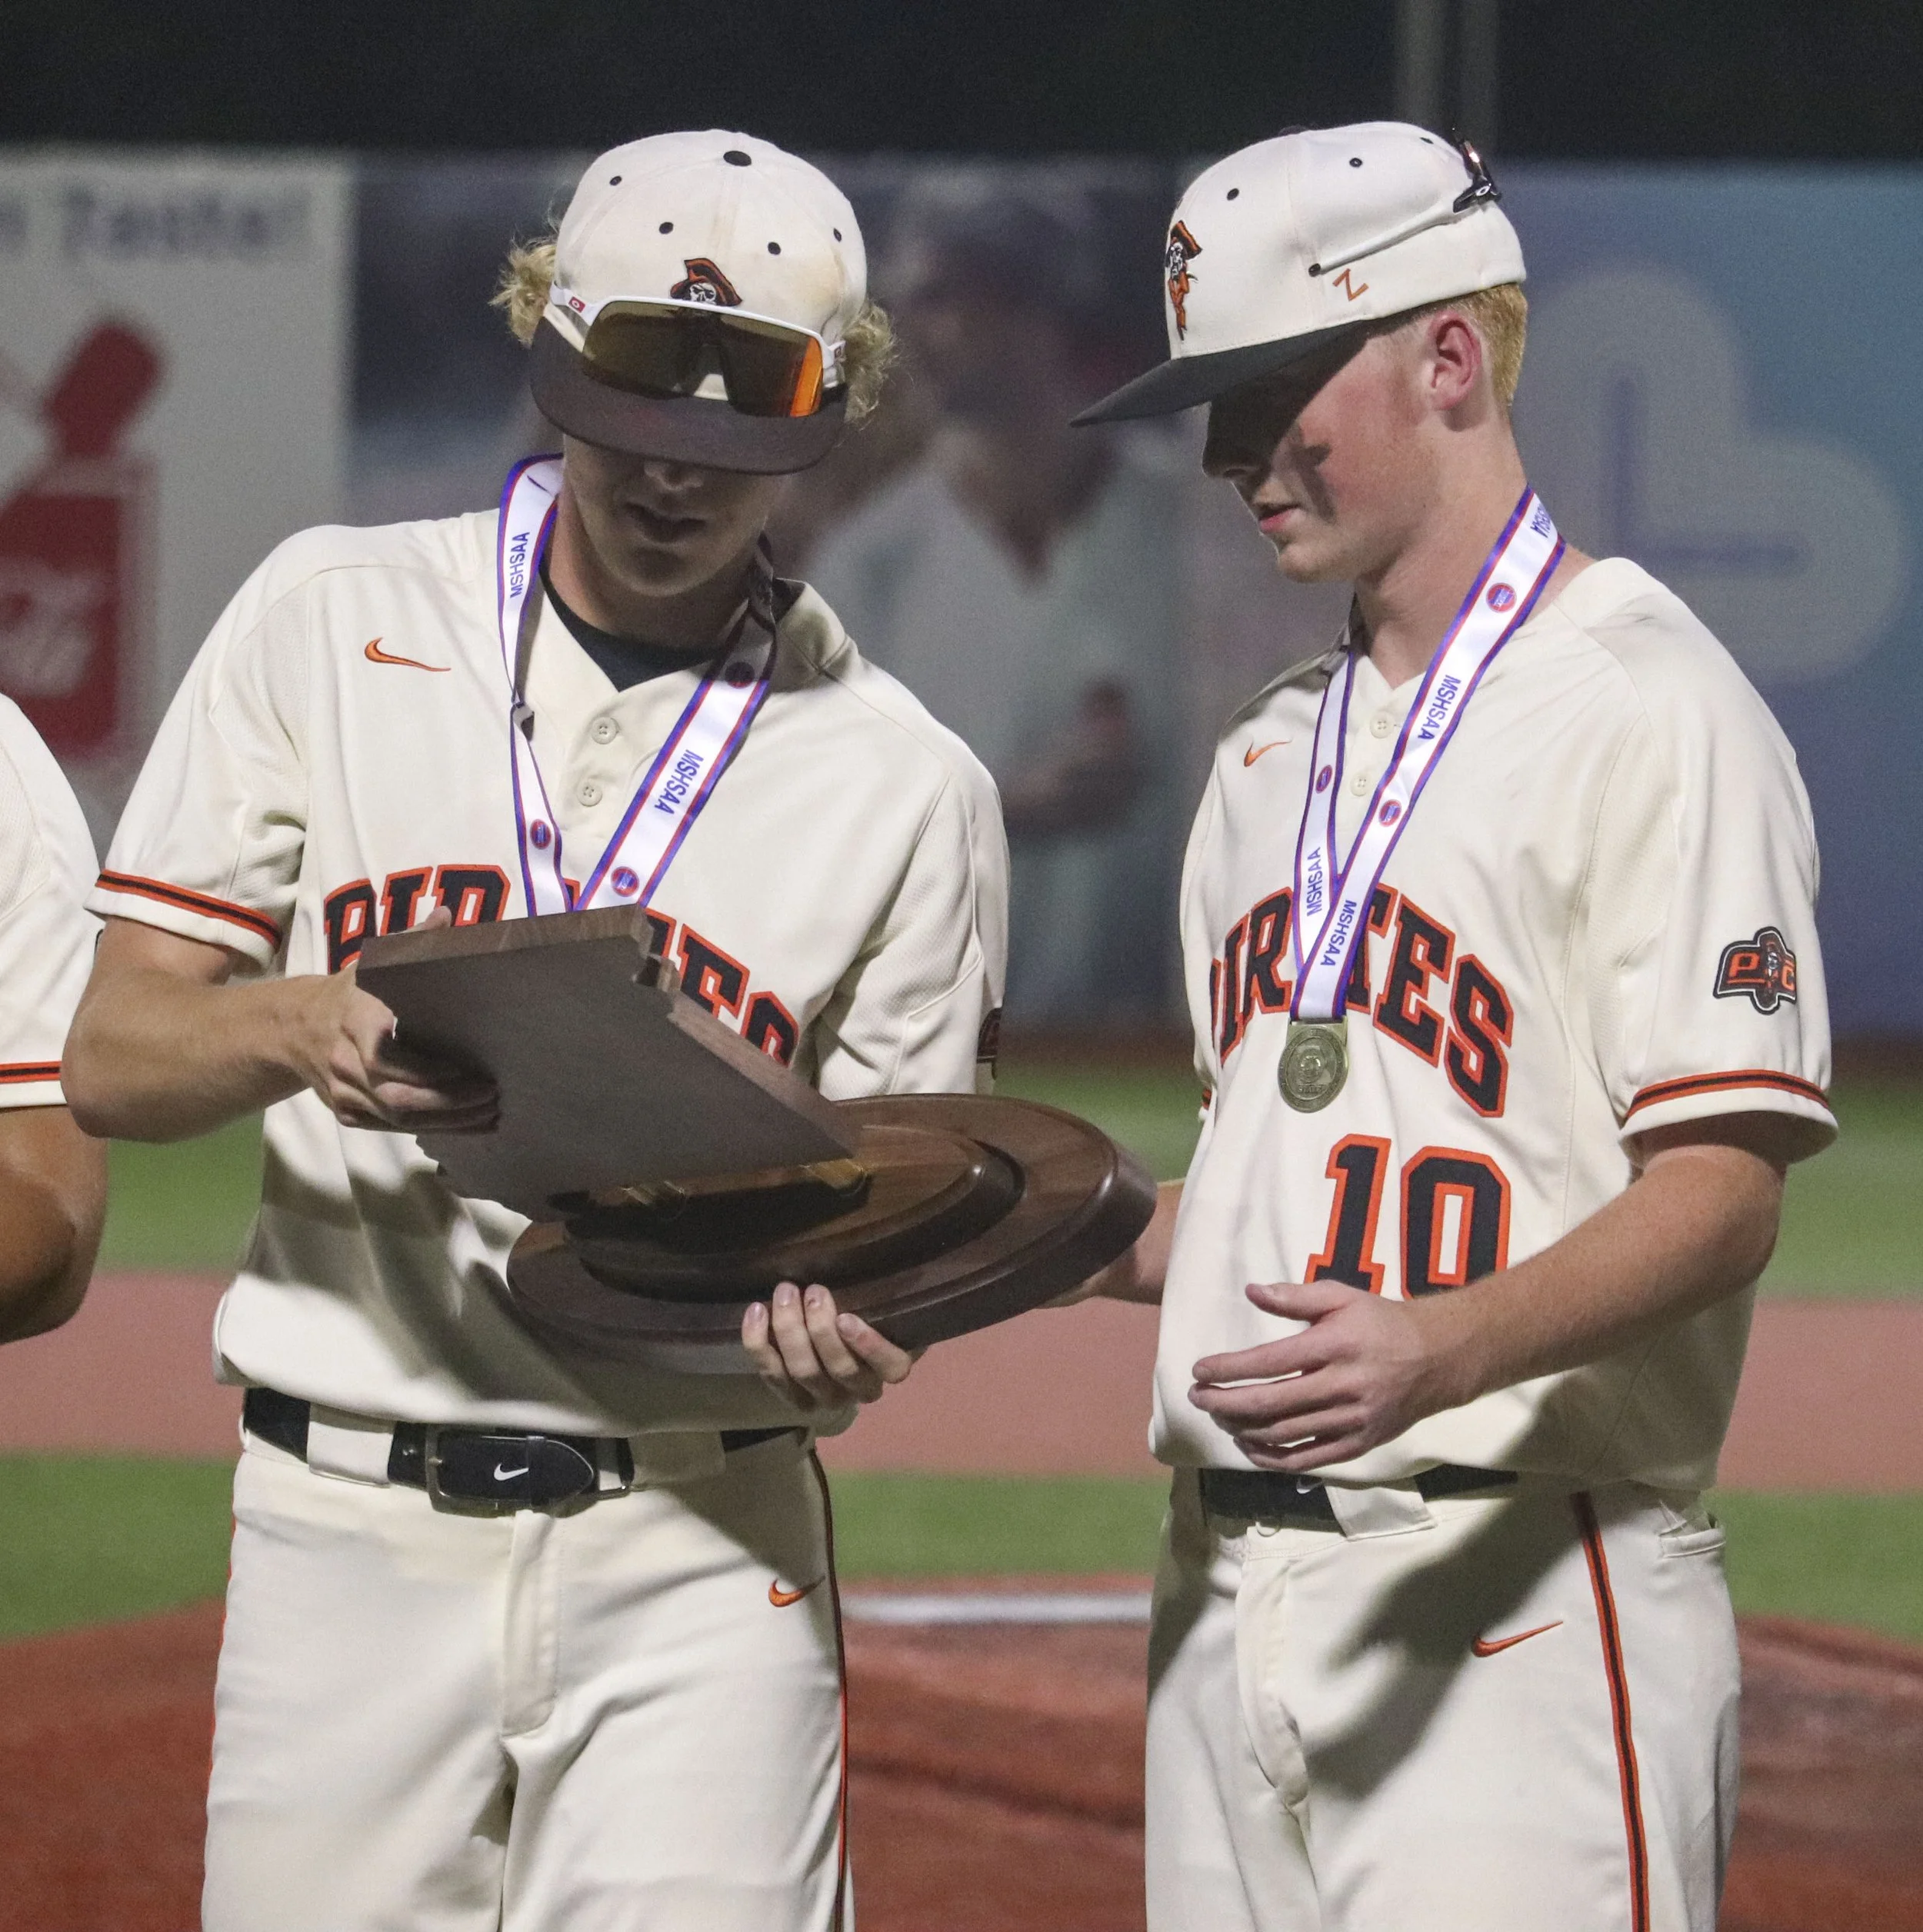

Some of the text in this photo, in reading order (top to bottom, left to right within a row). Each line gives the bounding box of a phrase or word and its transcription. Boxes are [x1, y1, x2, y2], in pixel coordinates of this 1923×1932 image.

[510, 531, 530, 598] MSHSAA
[1418, 675, 1461, 740] MSHSAA
[655, 749, 704, 814] MSHSAA
[1307, 846, 1322, 917] MSHSAA
[1321, 900, 1357, 967] MSHSAA
[1304, 1133, 1511, 1300] 10
